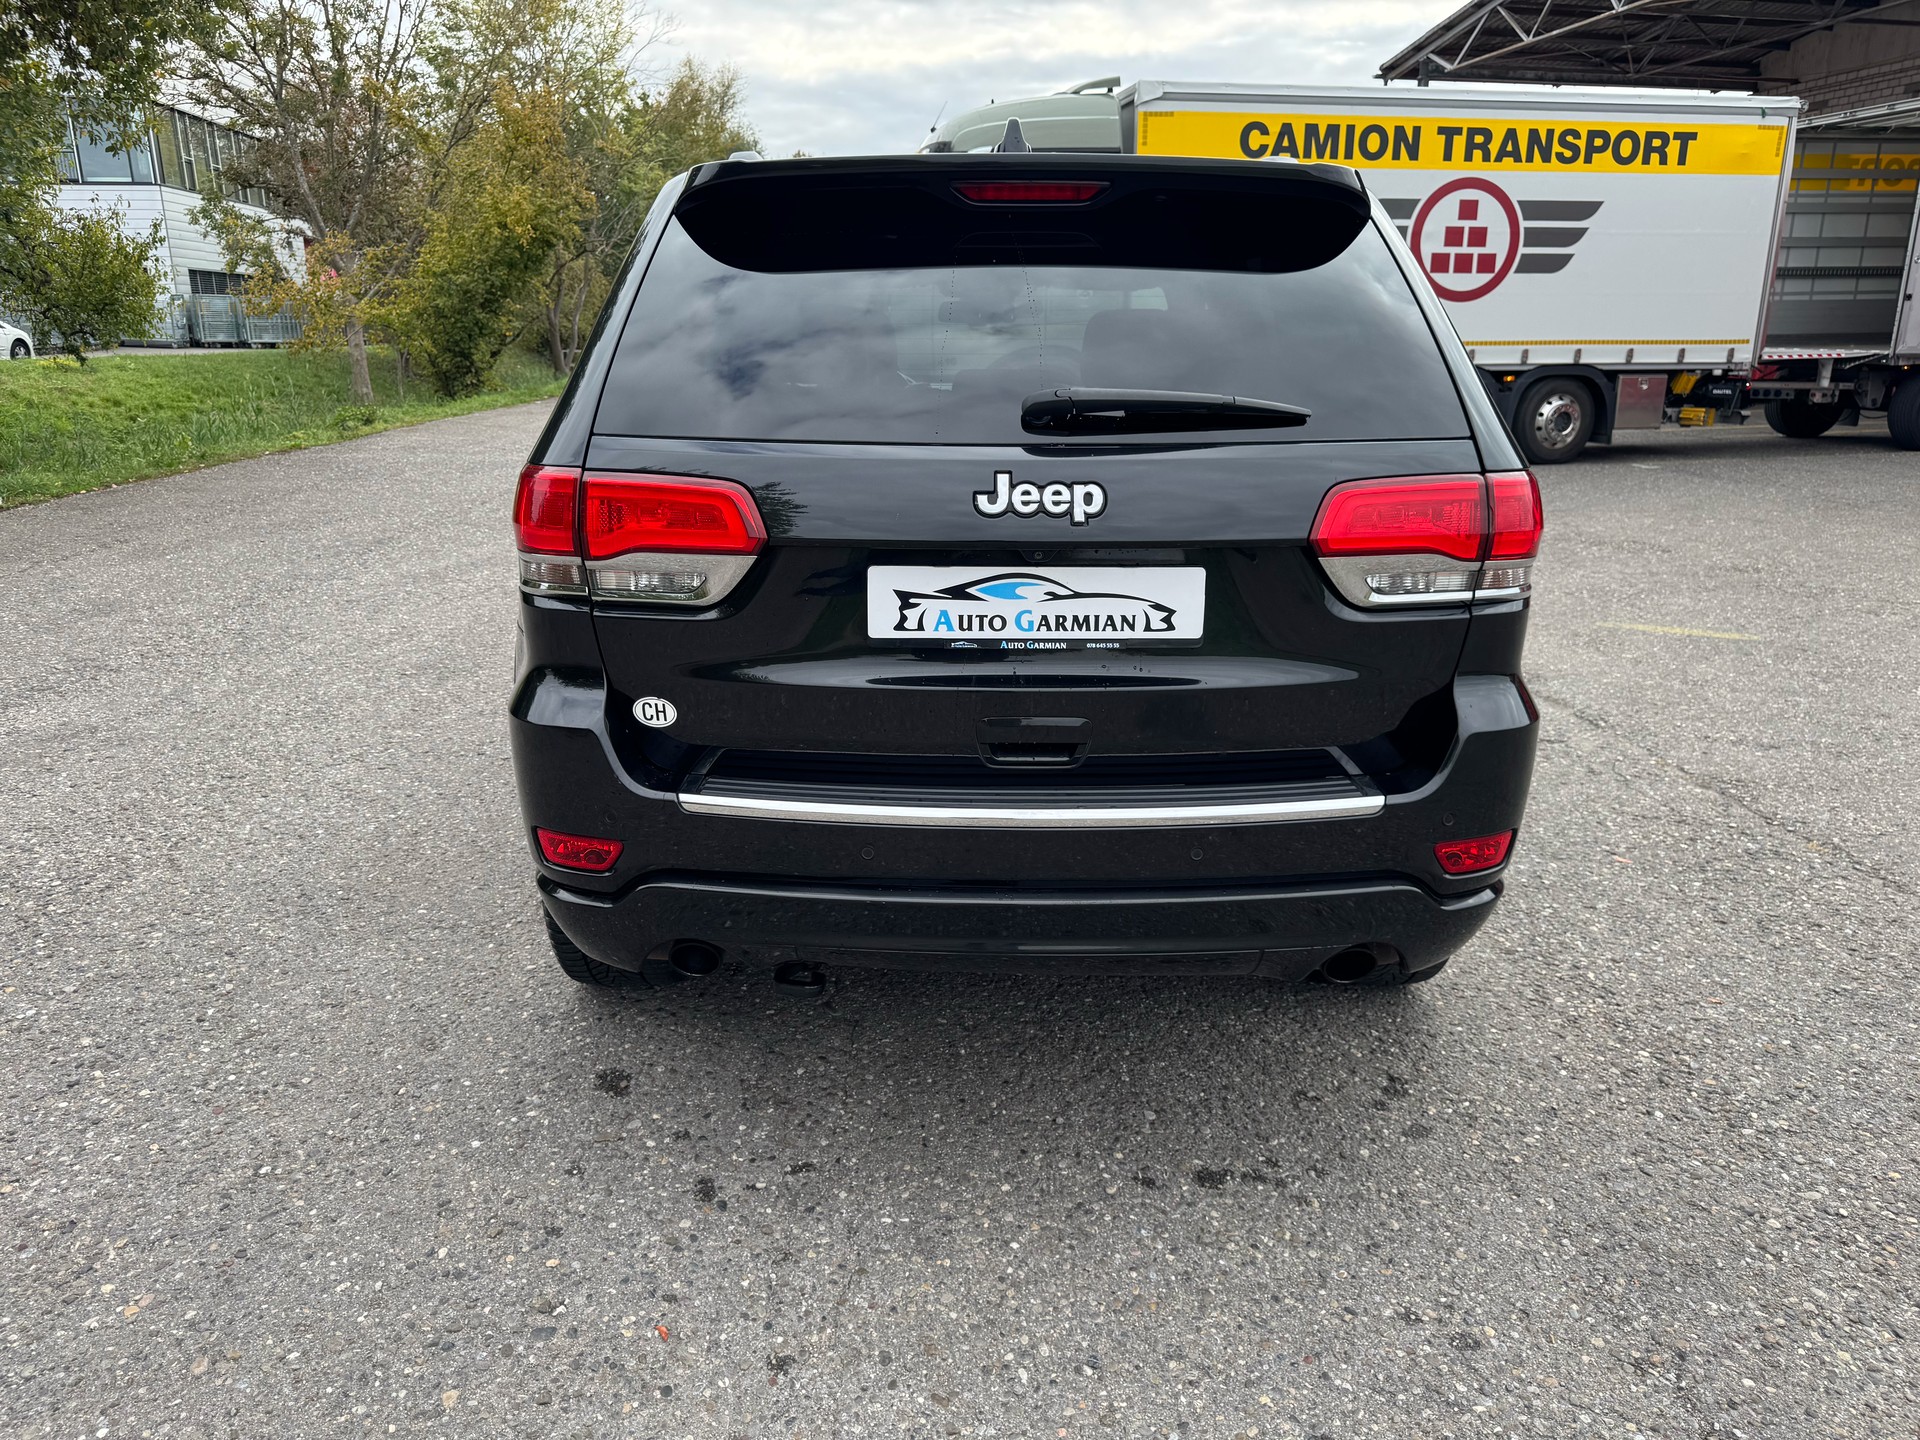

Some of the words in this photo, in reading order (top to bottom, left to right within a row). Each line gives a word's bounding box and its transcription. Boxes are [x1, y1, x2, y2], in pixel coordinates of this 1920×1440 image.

[1239, 121, 1421, 162] CAMION
[1436, 126, 1698, 166] TRANSPORT
[975, 472, 1105, 524] Jeep
[933, 609, 1007, 632] AUTO
[1014, 609, 1136, 632] GARMIAN
[1000, 641, 1025, 650] AUTO
[1026, 640, 1067, 650] GARMIAN
[641, 701, 668, 722] CH
